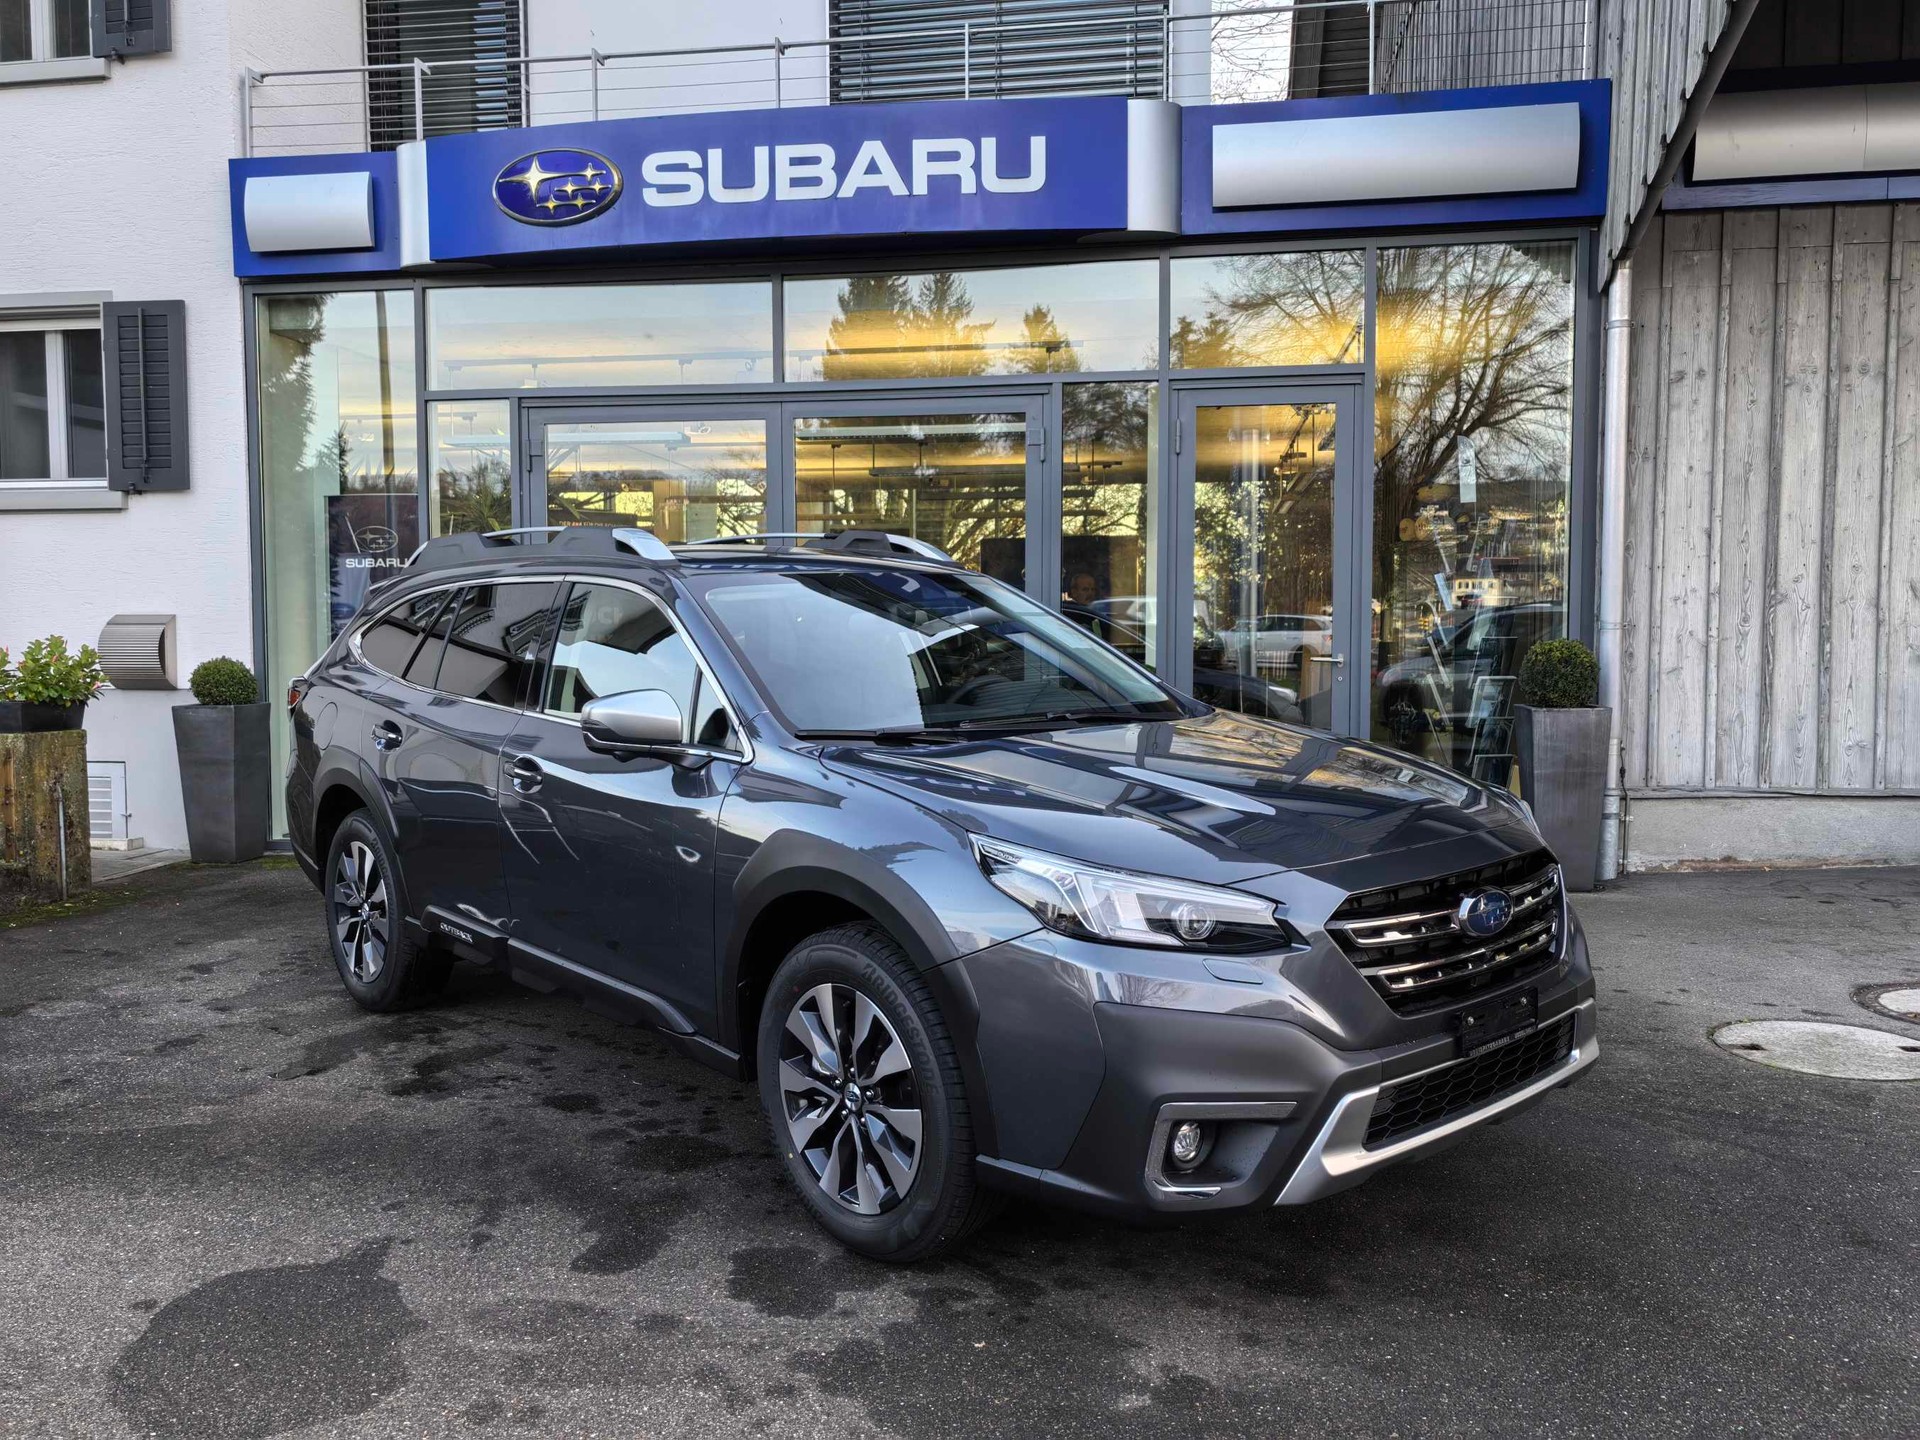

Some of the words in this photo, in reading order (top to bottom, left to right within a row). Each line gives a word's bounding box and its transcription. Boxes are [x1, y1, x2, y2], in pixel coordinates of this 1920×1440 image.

[641, 135, 1047, 208] SUBARU
[345, 557, 408, 568] SUBARU
[440, 922, 473, 943] OUTBACK
[862, 962, 941, 1096] BRIDGESTONE
